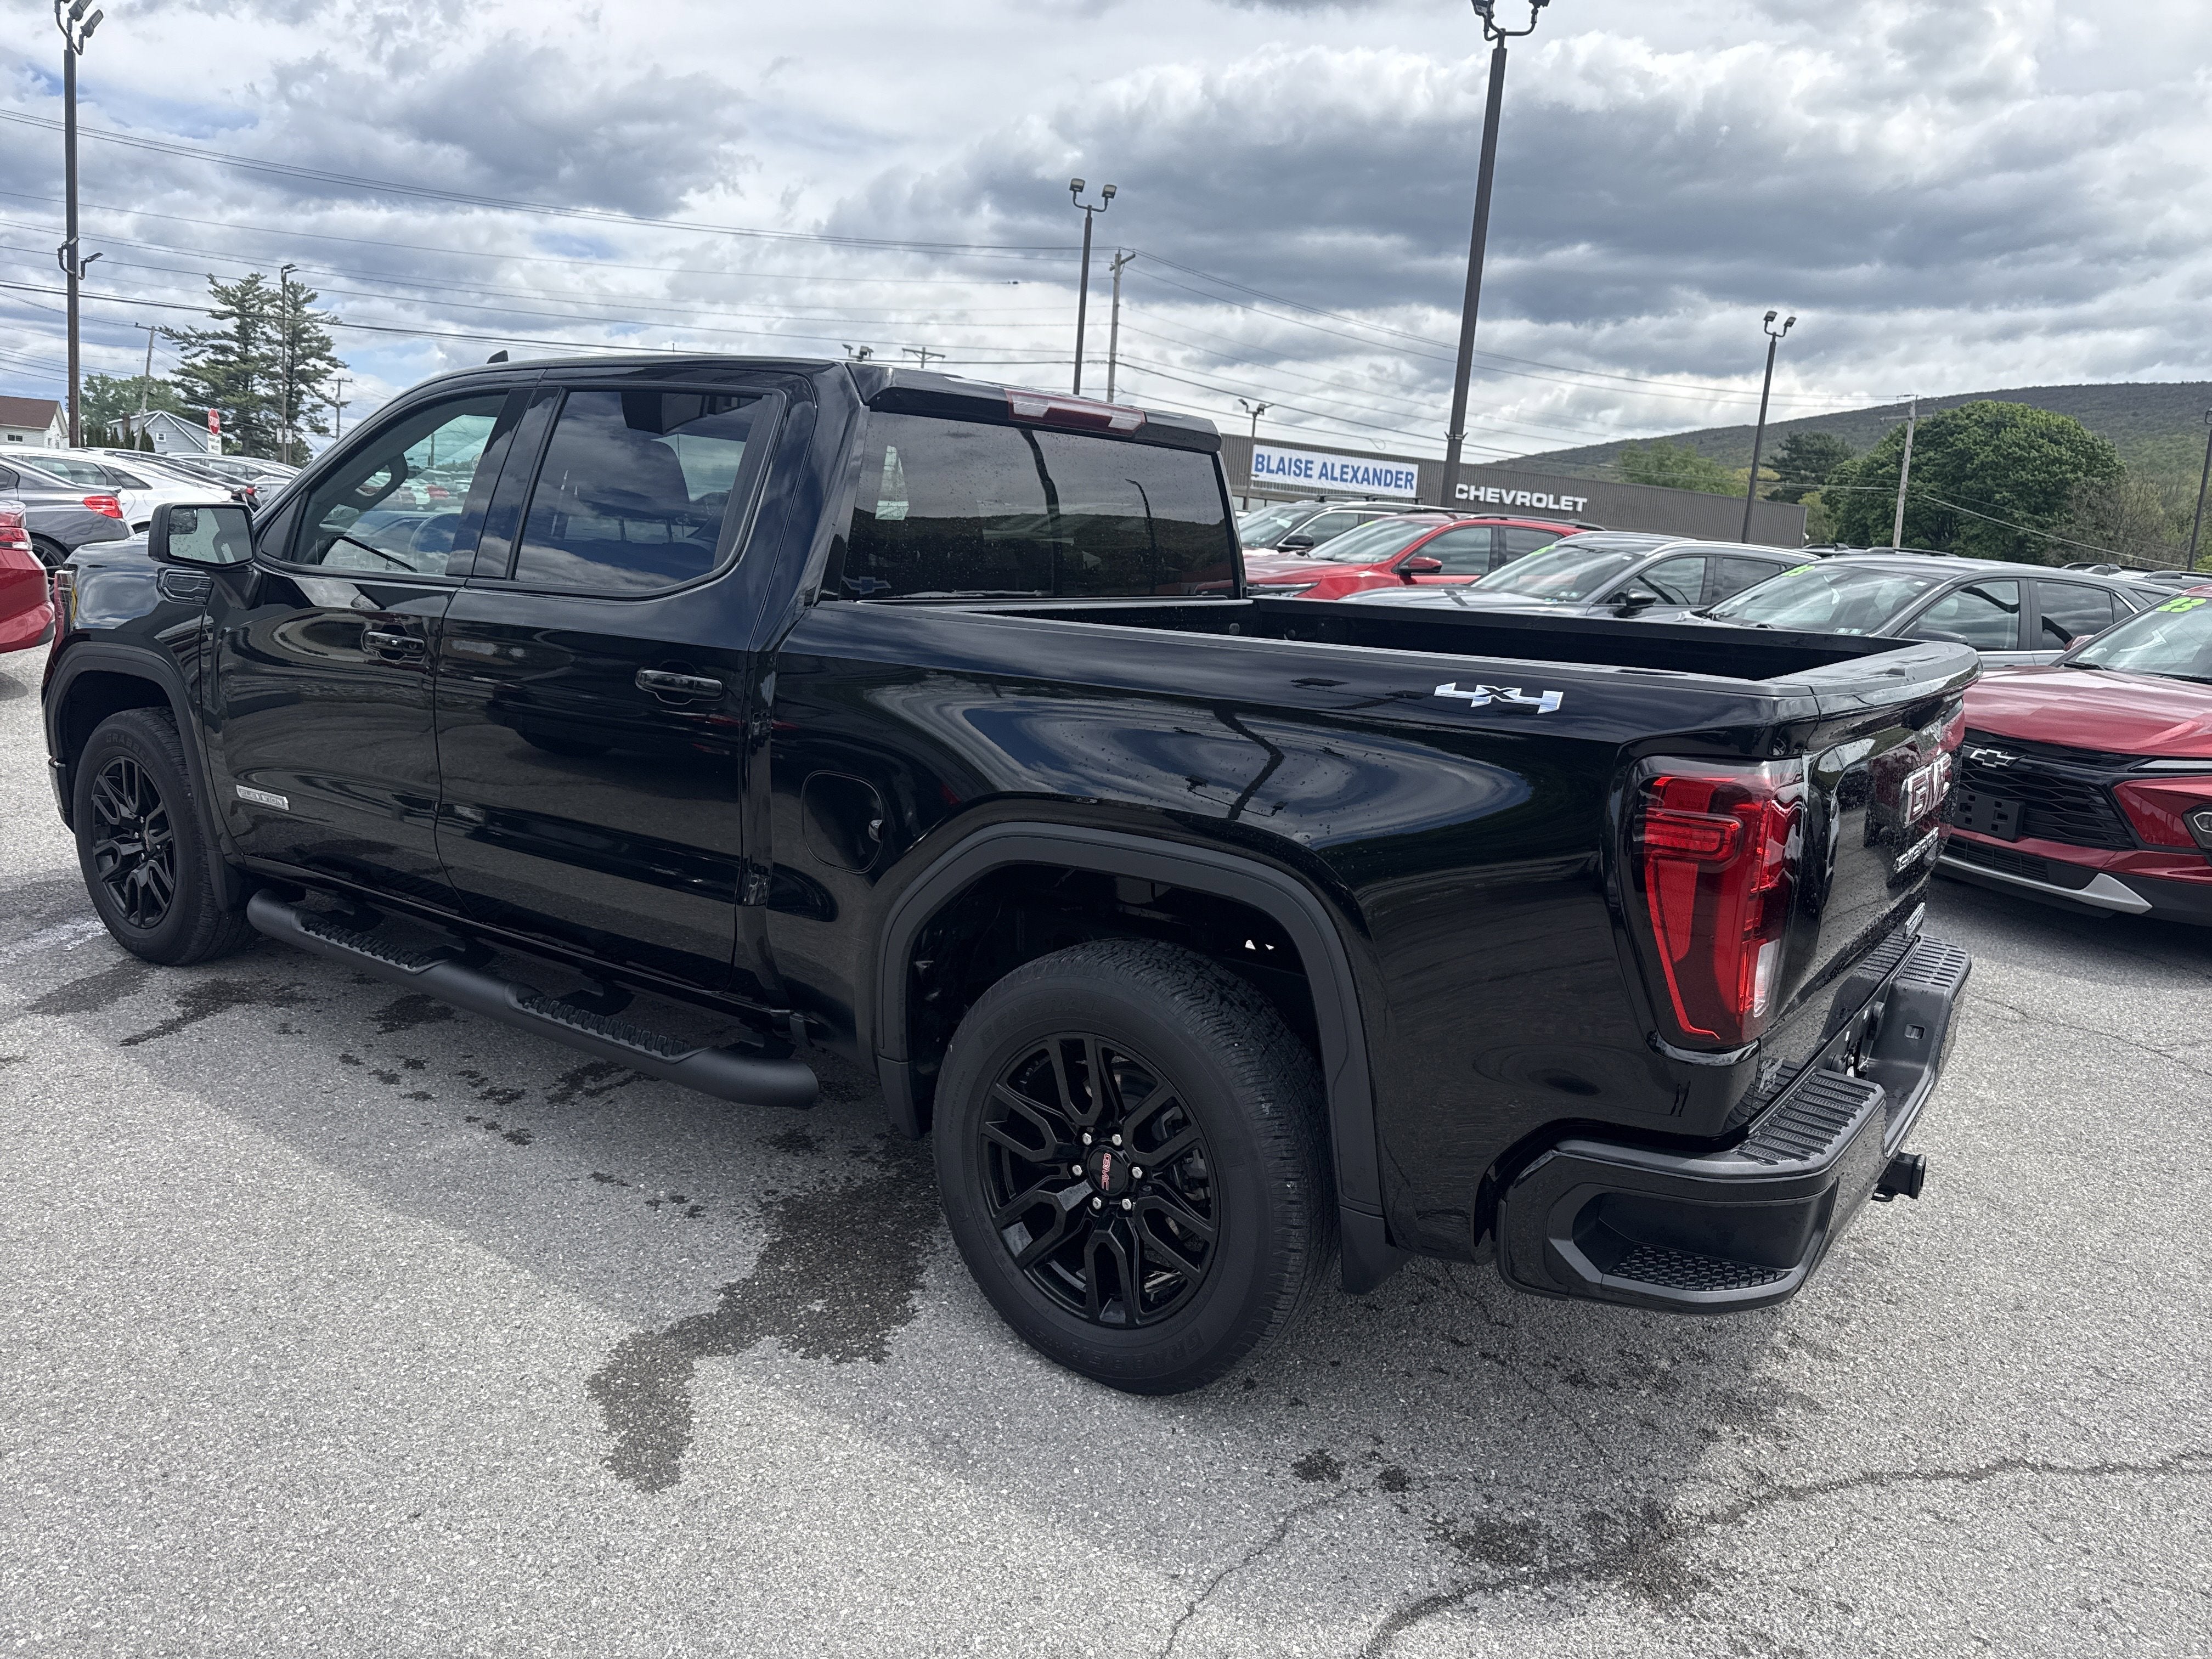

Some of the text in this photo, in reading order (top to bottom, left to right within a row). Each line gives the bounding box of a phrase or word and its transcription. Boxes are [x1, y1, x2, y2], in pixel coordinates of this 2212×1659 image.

[1254, 453, 1414, 490] BLAISE ALEXANDER
[1455, 483, 1588, 512] CHEVROLET
[1899, 752, 1952, 828] GMC
[980, 995, 1104, 1049] GENERAL
[1101, 1153, 1111, 1191] GMC
